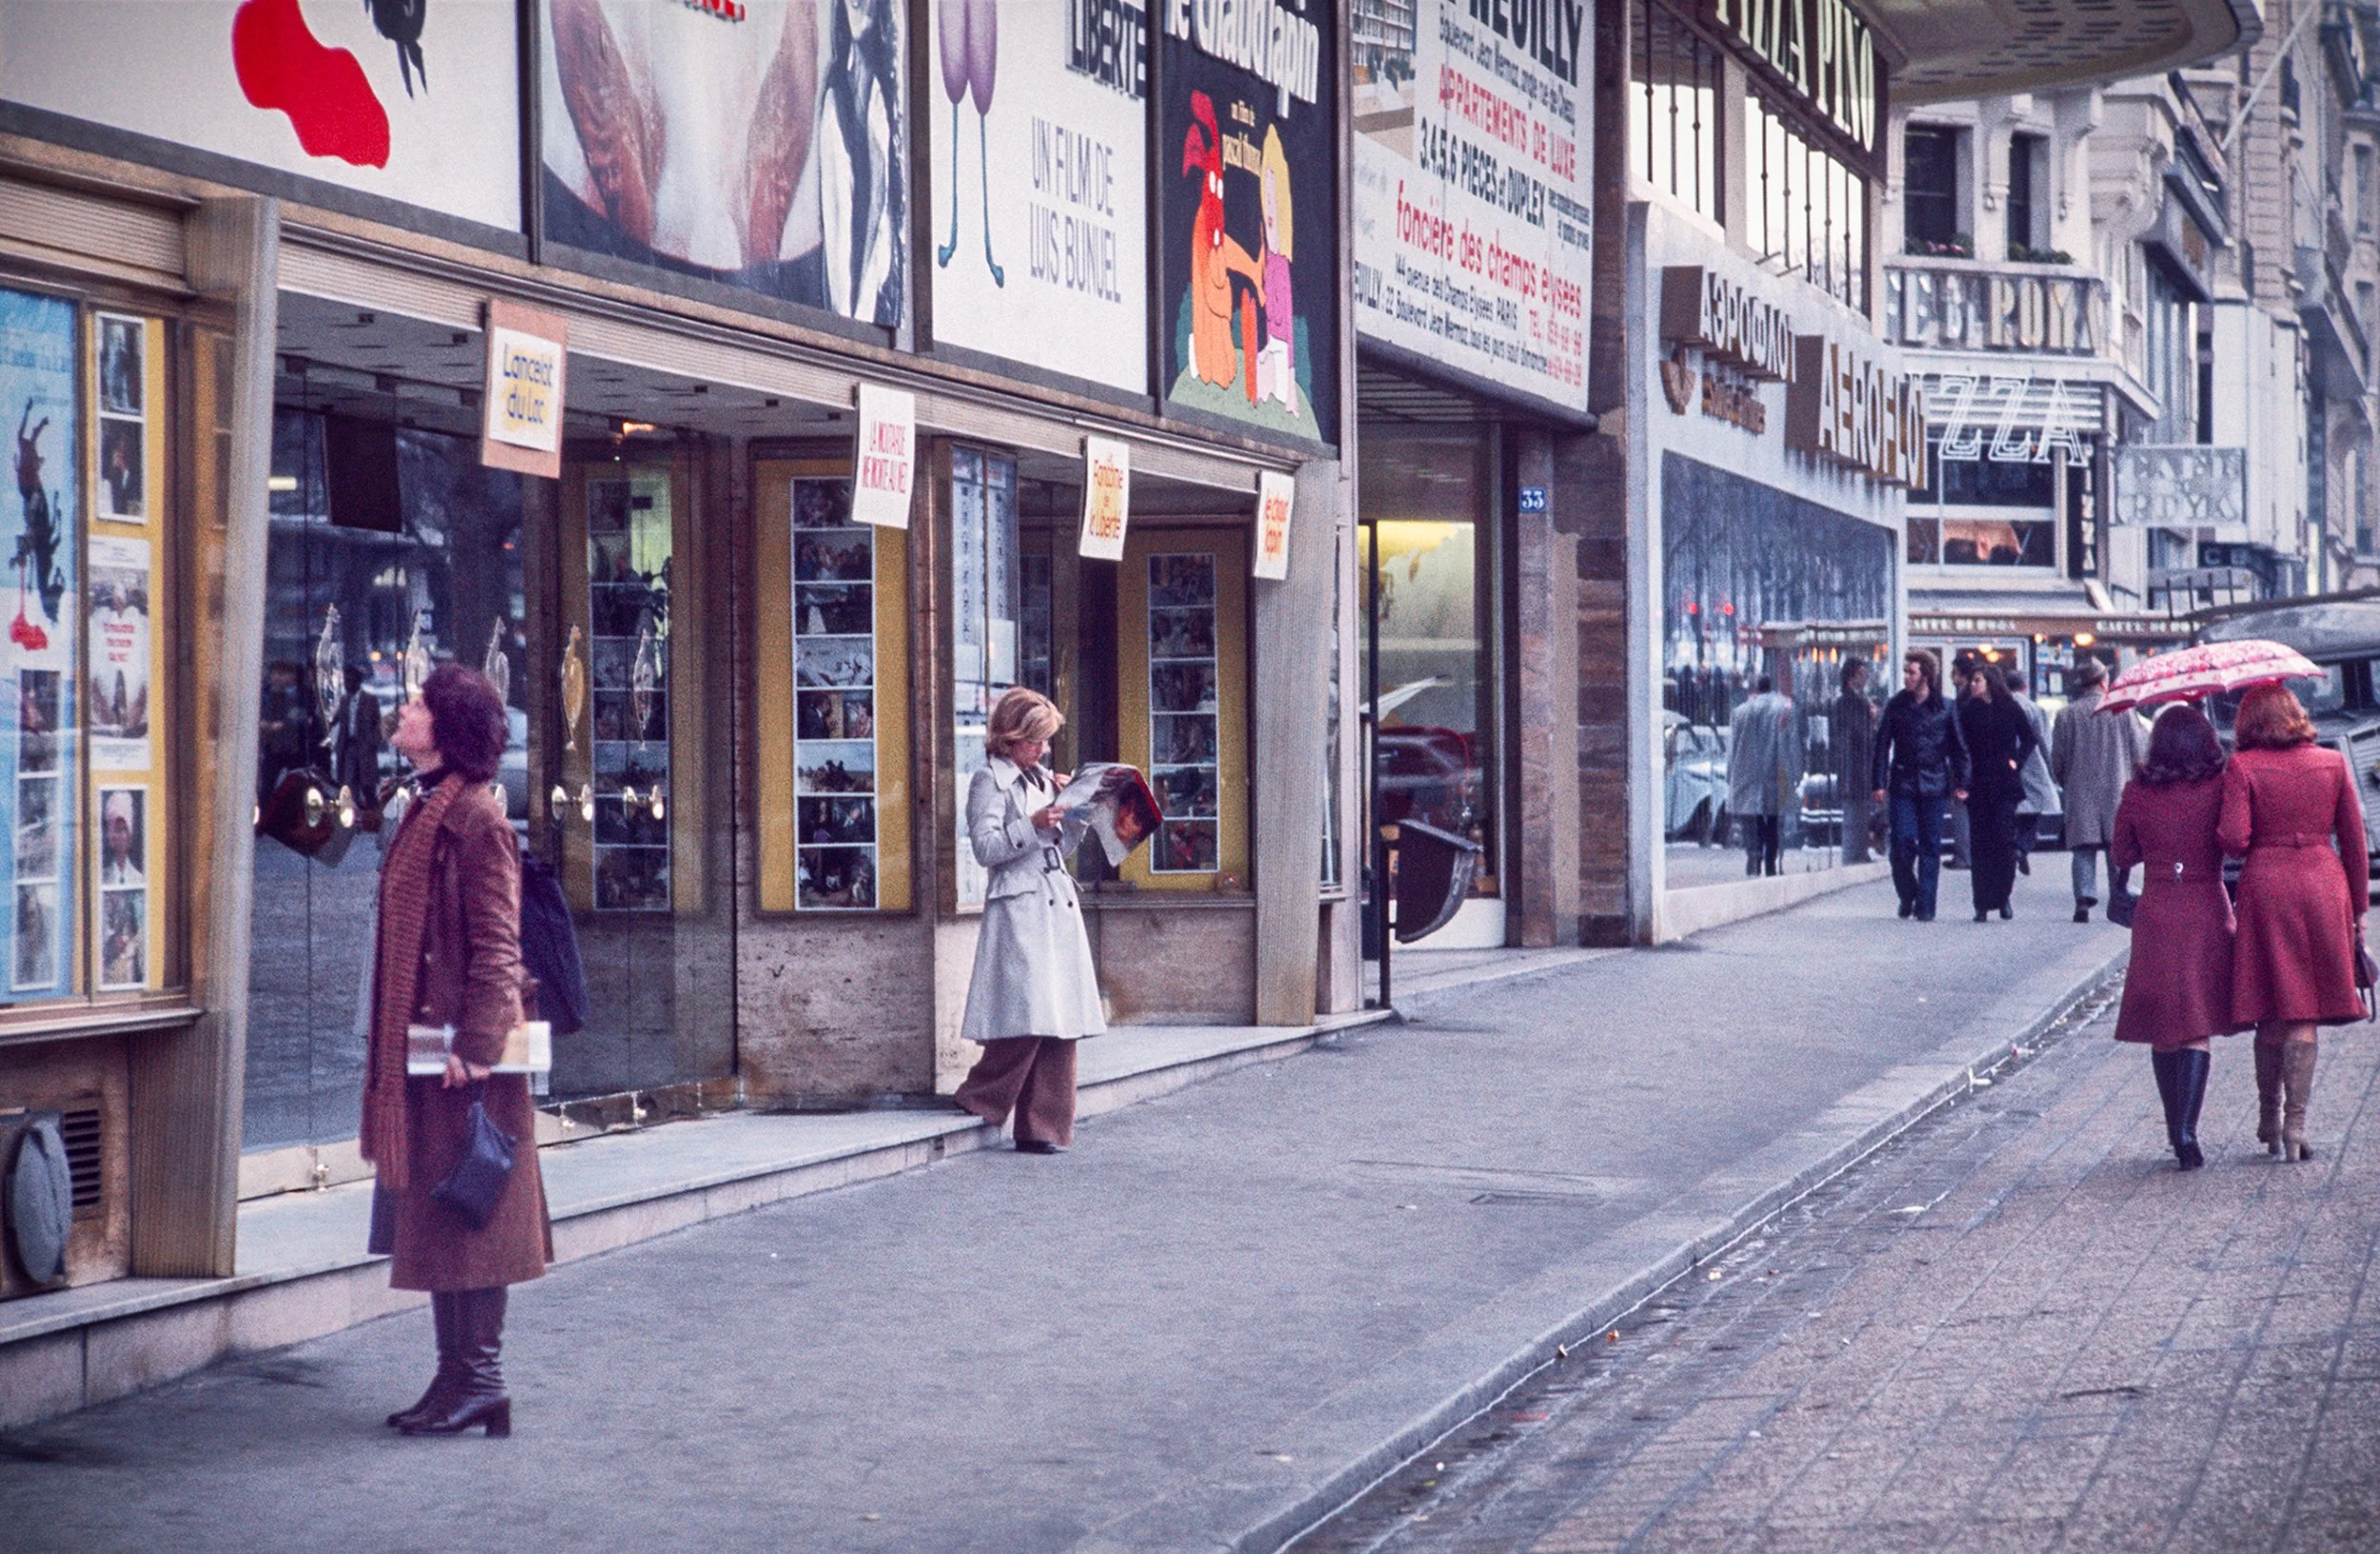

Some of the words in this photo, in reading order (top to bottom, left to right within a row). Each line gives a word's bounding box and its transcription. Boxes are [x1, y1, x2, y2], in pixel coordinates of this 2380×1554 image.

[1470, 0, 1582, 88] UILLY
[1032, 115, 1050, 194] UN
[1056, 126, 1091, 208] FILM
[1096, 142, 1114, 218] DE
[1438, 64, 1527, 155] APPARTEMENTS
[1533, 120, 1546, 164] DE
[1551, 130, 1576, 183] LUXE
[1460, 140, 1497, 205] PIECES
[1508, 166, 1545, 229] DUPLEX
[1030, 202, 1059, 285] LUIS
[1459, 217, 1482, 274] des
[1488, 228, 1537, 305] champs
[1497, 296, 1518, 331] PARIS
[503, 343, 552, 388] Lancelot
[507, 385, 525, 420] du
[526, 387, 544, 424] Lac
[1818, 340, 1928, 490] AEROFLOT
[1931, 370, 2090, 467] ZZA
[1521, 489, 1544, 510] 33
